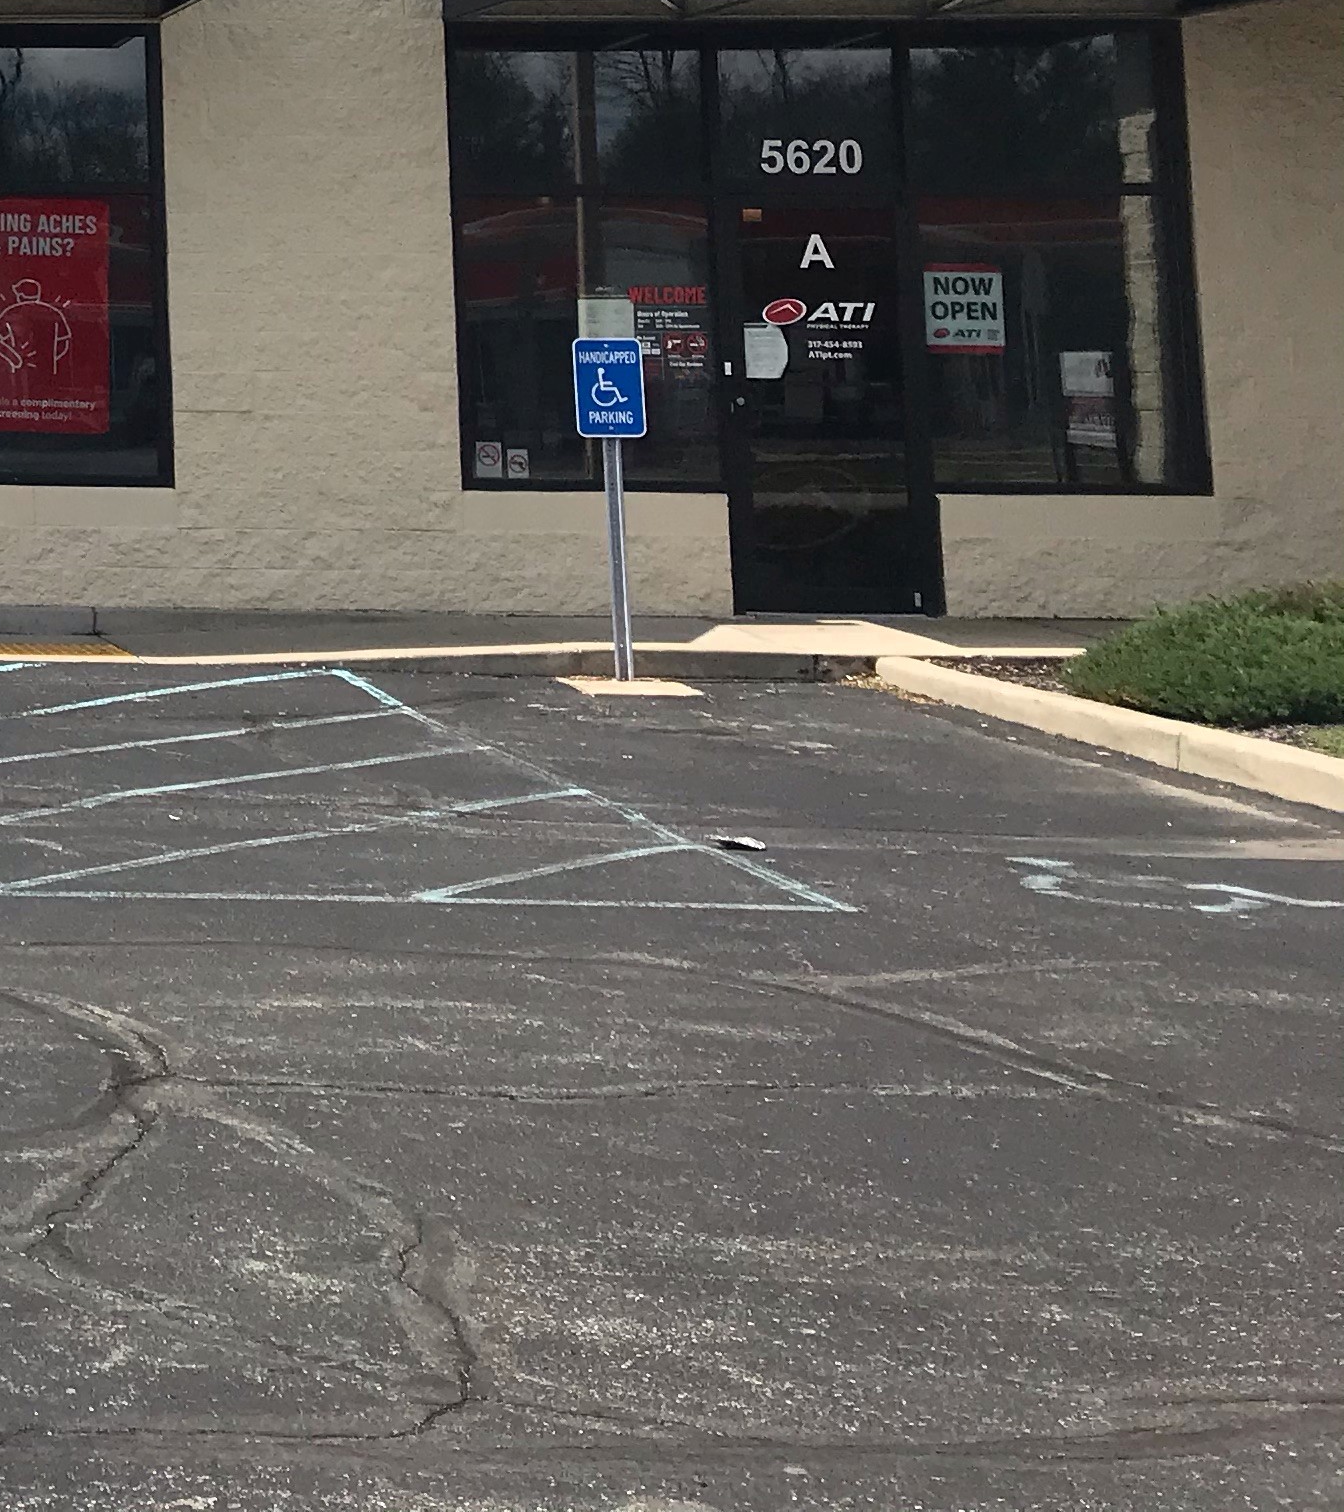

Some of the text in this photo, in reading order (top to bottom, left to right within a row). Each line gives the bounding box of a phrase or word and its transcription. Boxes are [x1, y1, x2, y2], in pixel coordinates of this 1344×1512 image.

[761, 139, 863, 174] 5620
[37, 214, 98, 235] ACHES
[8, 236, 75, 257] PAINS?
[799, 233, 836, 269] A
[627, 286, 707, 305] WELCOME
[933, 276, 994, 296] NOW
[807, 302, 876, 322] ATI
[930, 300, 998, 321] OPEN
[953, 329, 981, 338] ATI
[578, 351, 637, 364] HANDICAPPED
[20, 398, 98, 411] complimentary
[588, 410, 634, 424] PARKING
